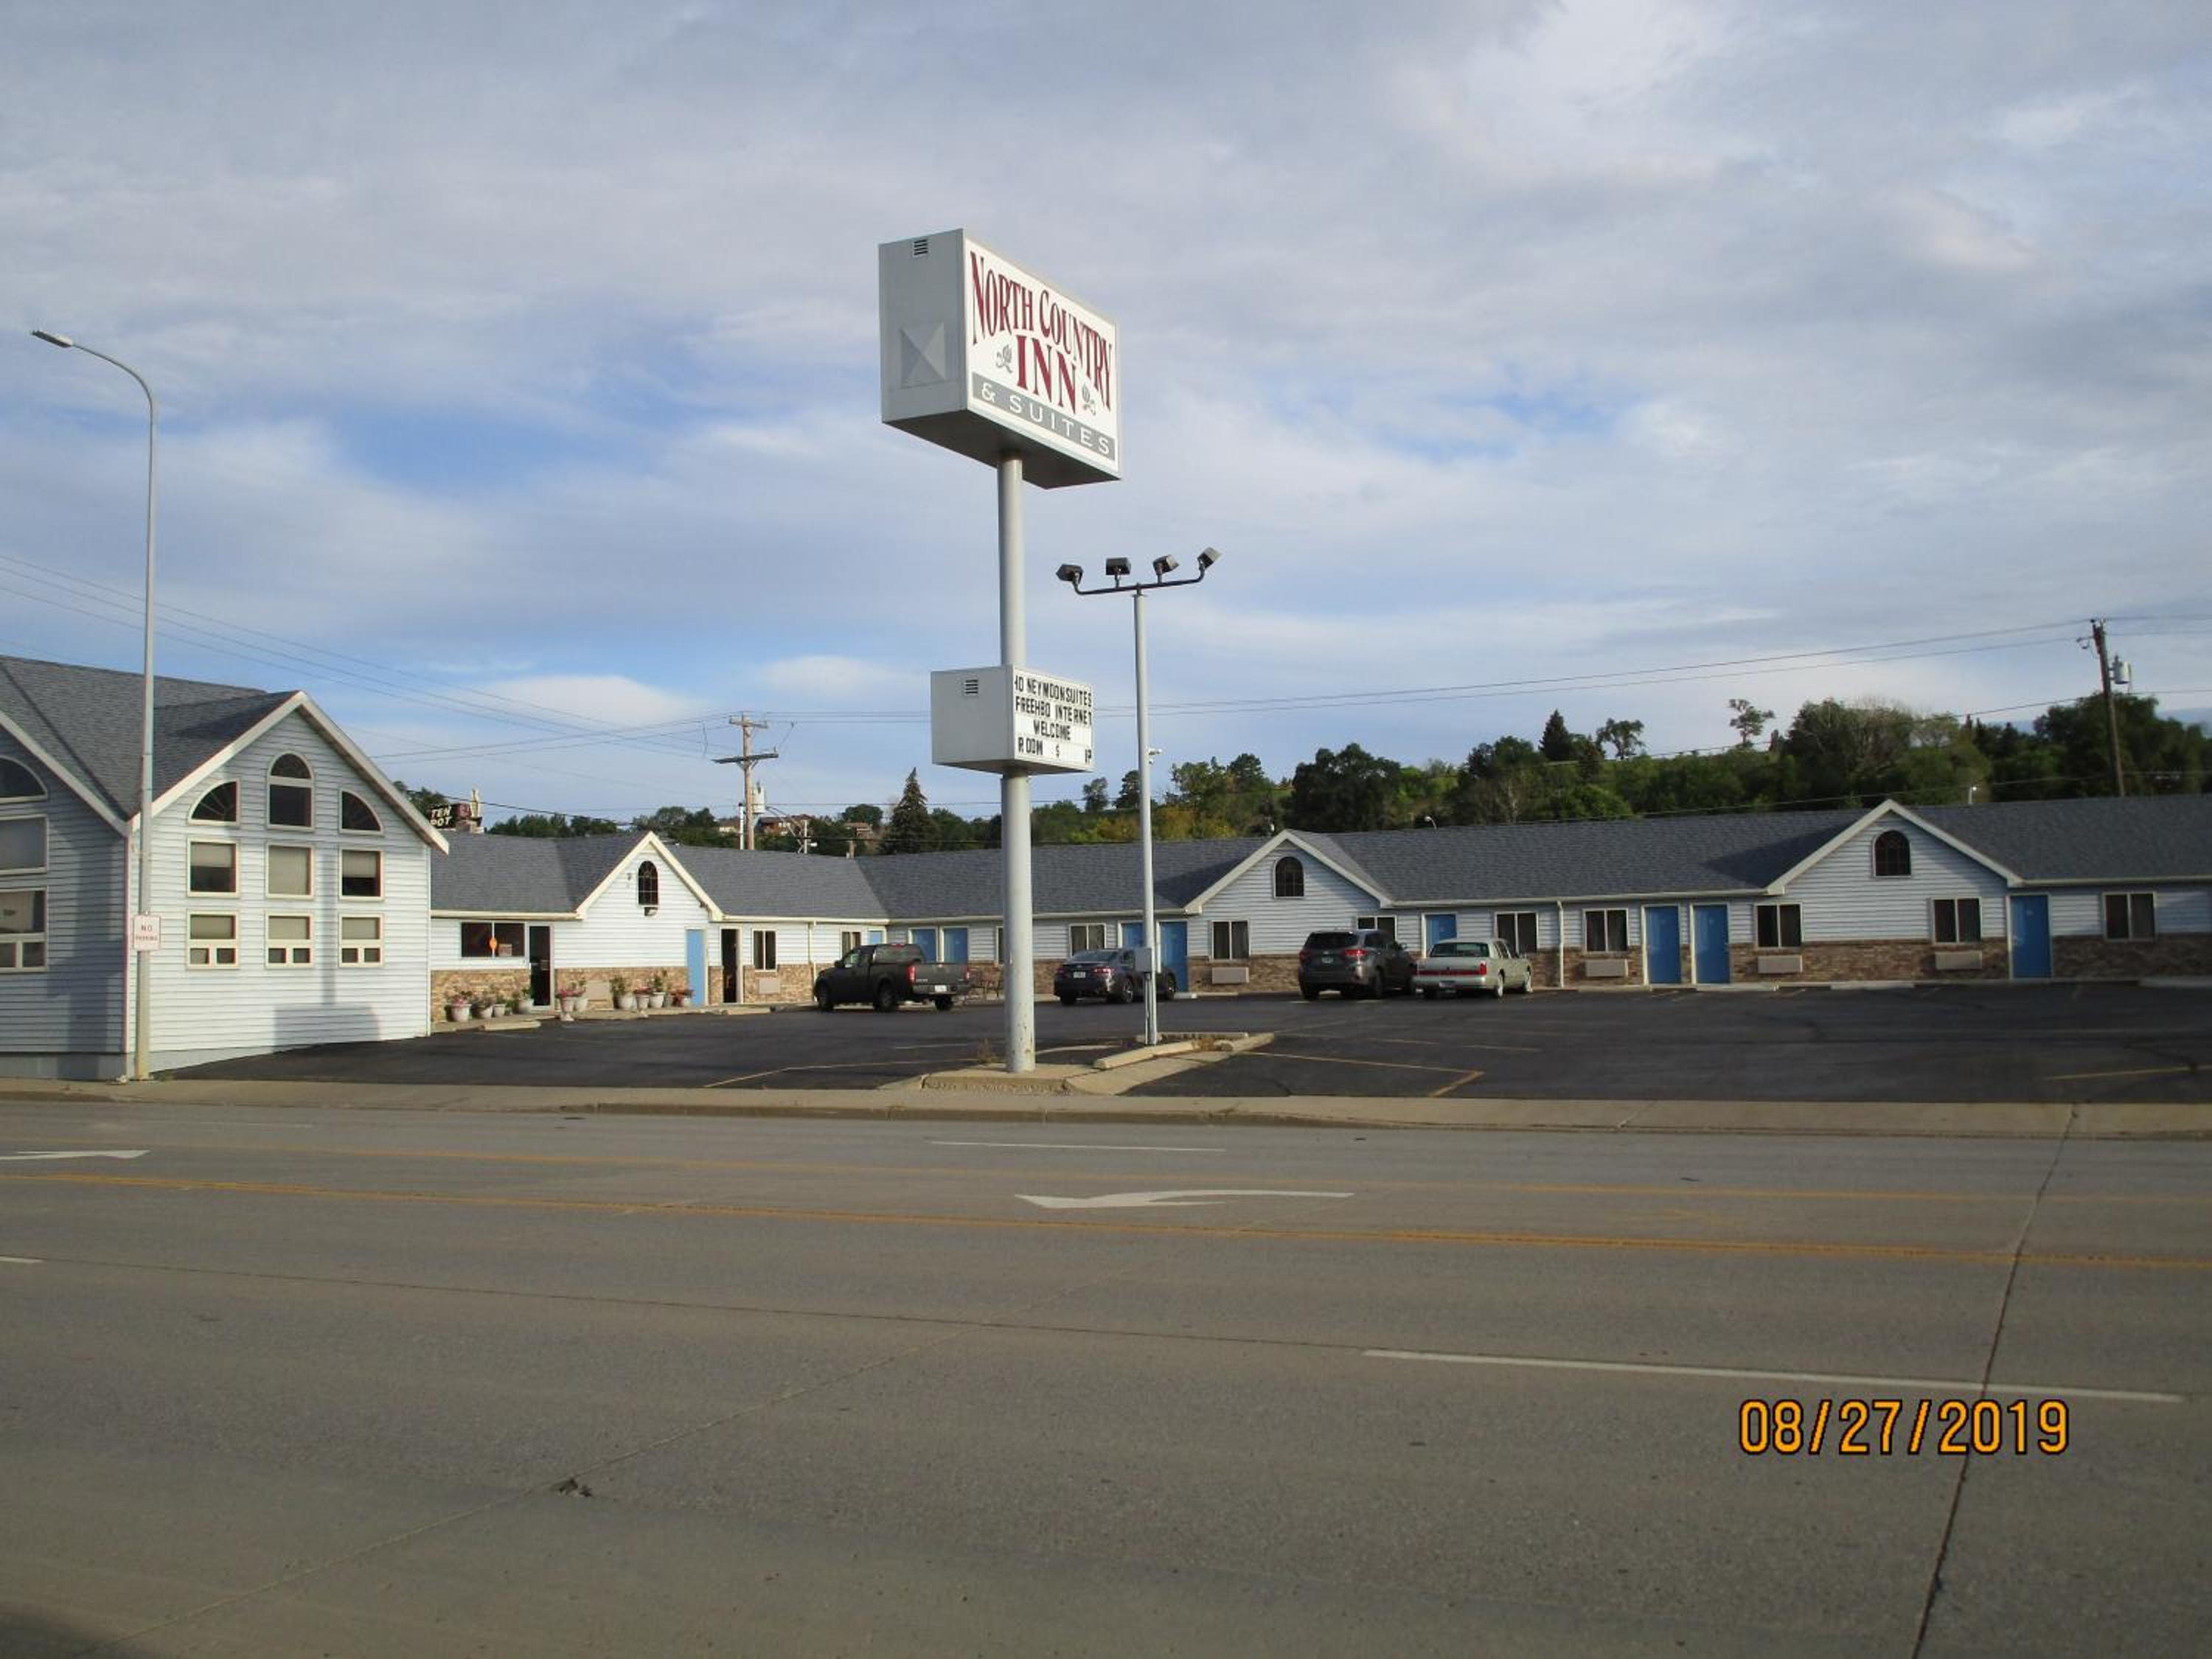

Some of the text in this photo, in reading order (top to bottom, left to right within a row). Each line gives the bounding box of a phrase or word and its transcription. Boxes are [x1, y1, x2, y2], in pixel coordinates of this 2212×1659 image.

[970, 251, 1112, 411] NORTH COUNTRY
[1016, 335, 1077, 414] INN
[981, 383, 1110, 455] & SUITES
[1034, 719, 1071, 741] WELCOME
[431, 806, 451, 817] TEN
